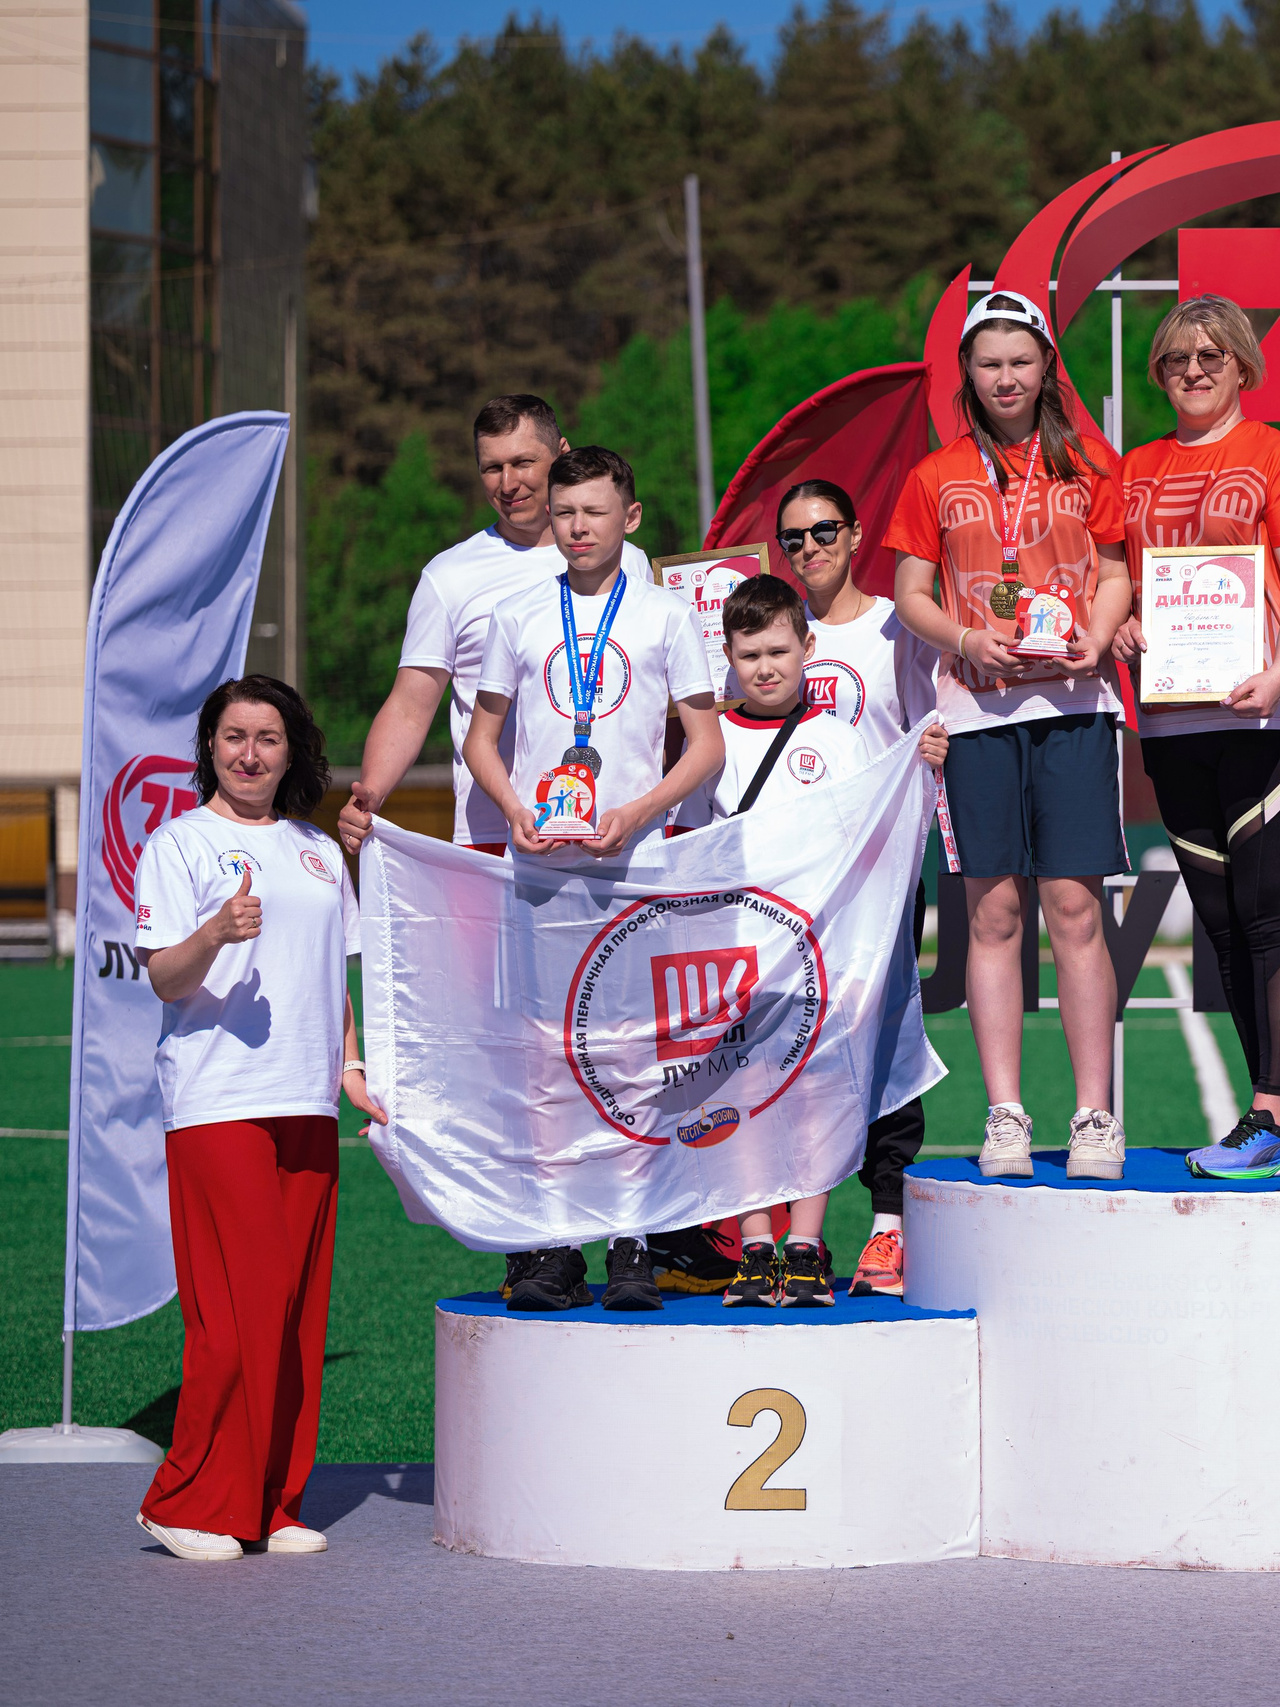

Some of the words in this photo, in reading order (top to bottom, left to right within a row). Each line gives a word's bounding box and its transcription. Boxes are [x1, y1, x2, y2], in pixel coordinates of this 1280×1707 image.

[1155, 593, 1239, 608] ДИПЛОМ
[1187, 622, 1193, 631] 1
[534, 802, 552, 827] 2
[610, 894, 719, 947] ПРОФСОЮЗНАЯ
[723, 892, 804, 937] ОРГАНИЗАЦ
[576, 943, 615, 1029] ПЕРВИЧНАЯ
[779, 954, 820, 1072] «ЛУКОЙЛ-ПЕРМЬ»
[576, 1032, 636, 1127] ОБЪЕДИНЕННАЯ
[679, 1123, 701, 1142] НГСП
[712, 1108, 739, 1125] ROGWU
[725, 1388, 807, 1511] 2
